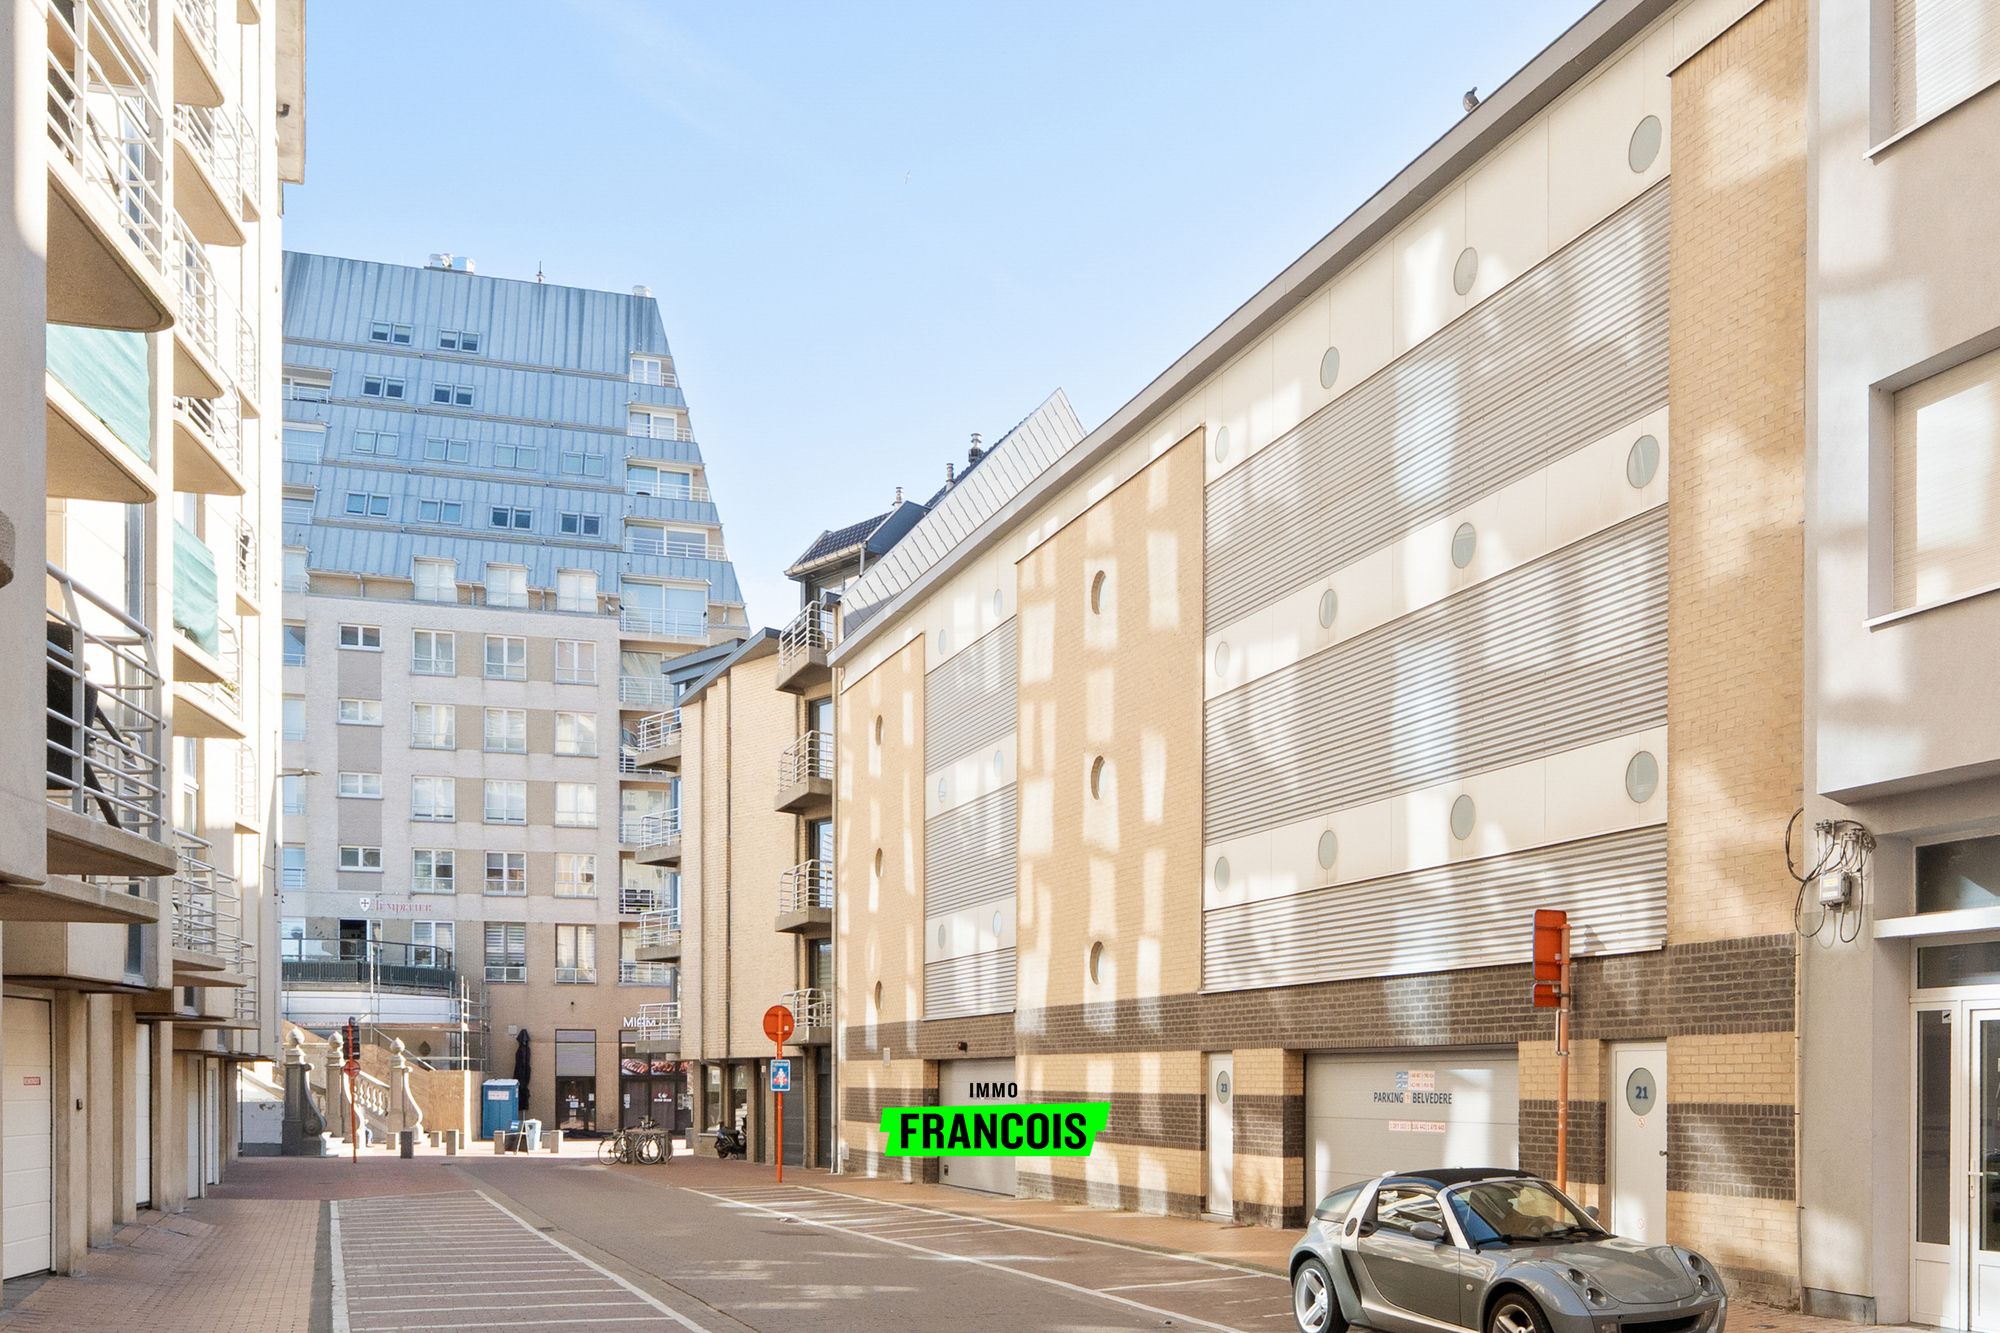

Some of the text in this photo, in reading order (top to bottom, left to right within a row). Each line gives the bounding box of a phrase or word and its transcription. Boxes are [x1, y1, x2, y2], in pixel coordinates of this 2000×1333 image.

[1373, 1092, 1453, 1105] PARKING BELVEDERE
[1635, 1086, 1649, 1100] 21
